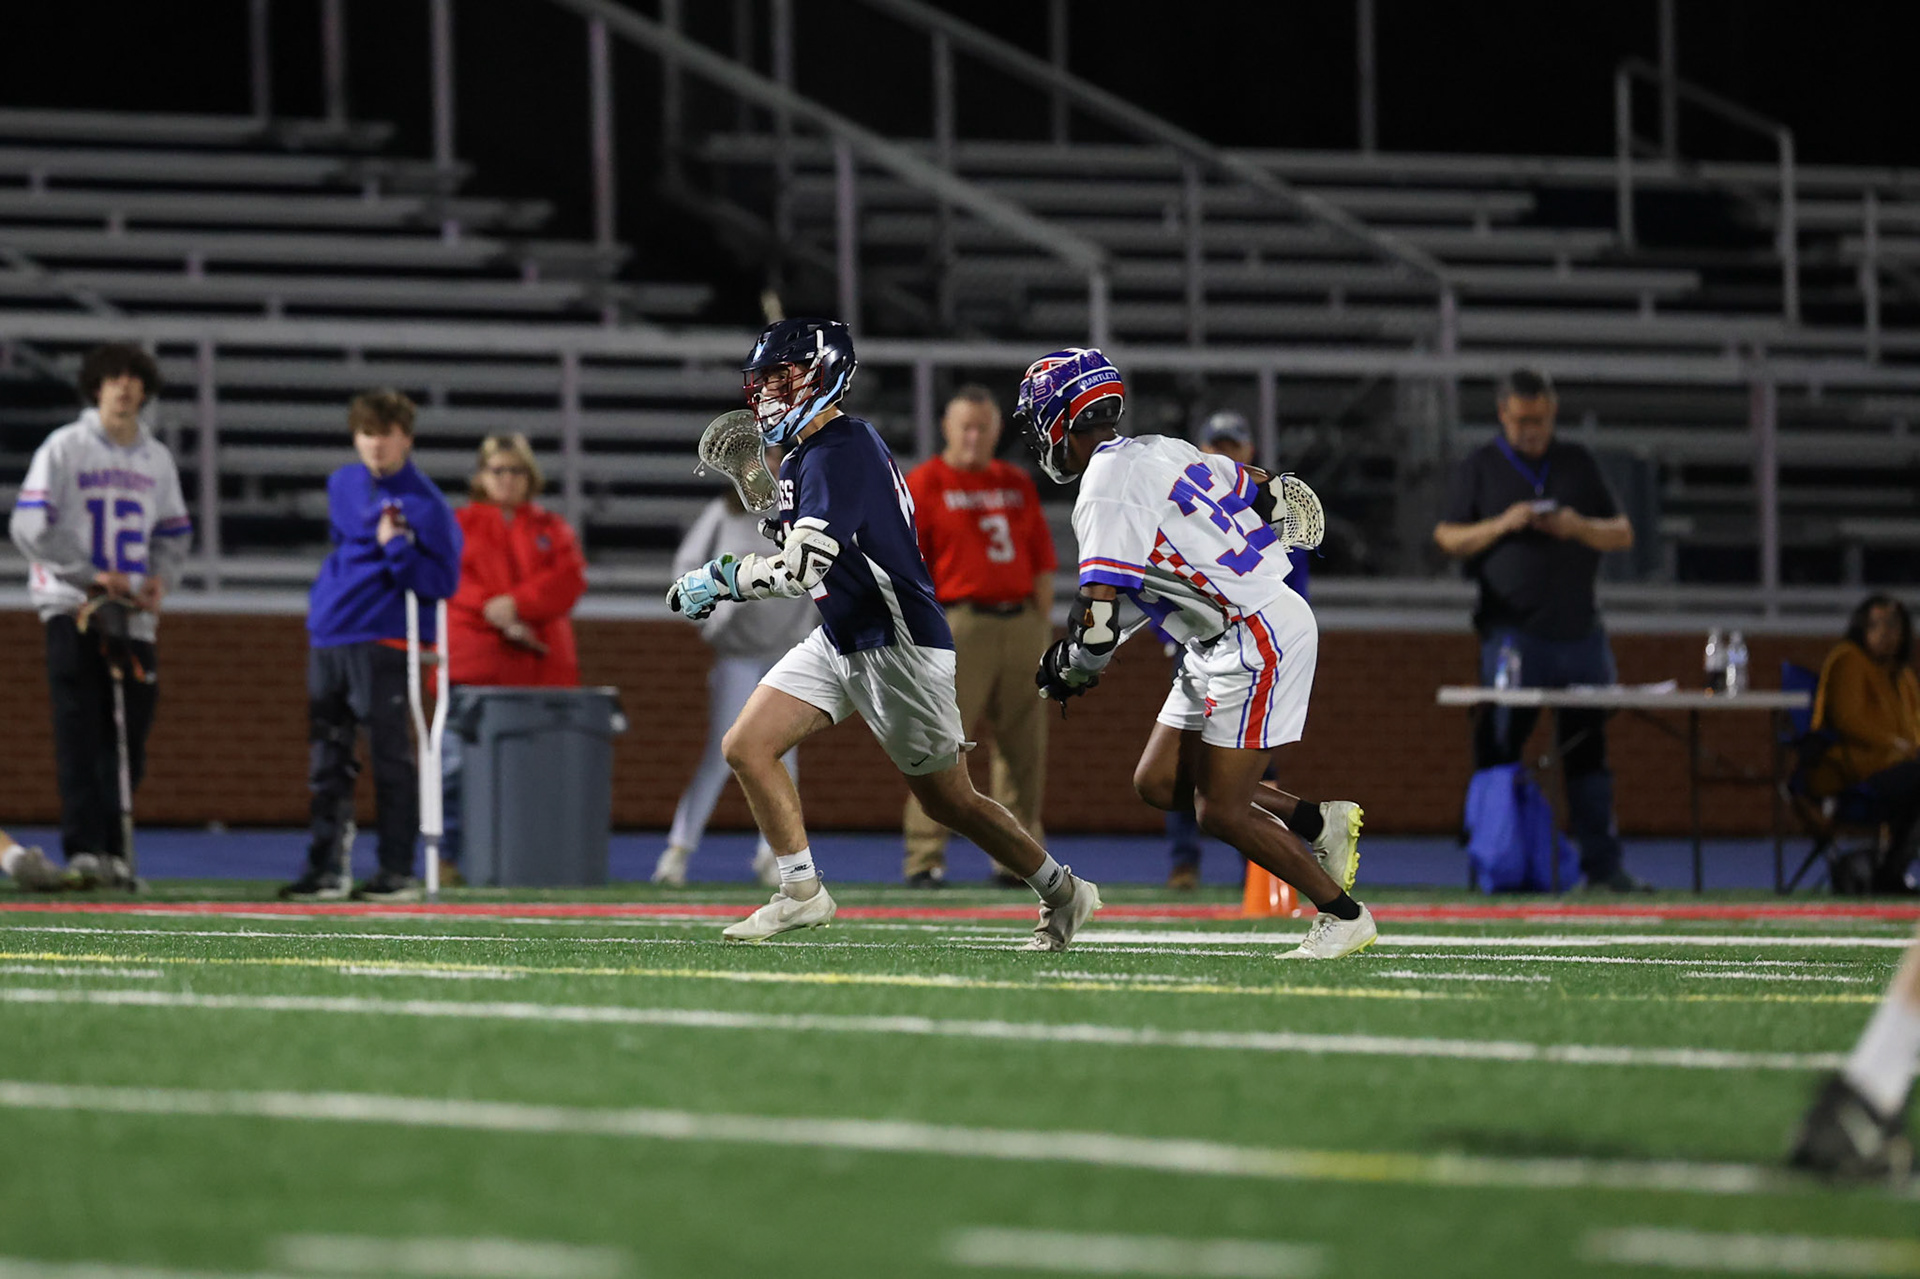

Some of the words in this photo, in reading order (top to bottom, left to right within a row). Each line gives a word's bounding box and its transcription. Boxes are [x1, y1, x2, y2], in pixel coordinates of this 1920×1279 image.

[1080, 371, 1118, 388] BARTLETT
[778, 479, 795, 511] ES
[86, 497, 147, 574] 12
[978, 514, 1016, 563] 3
